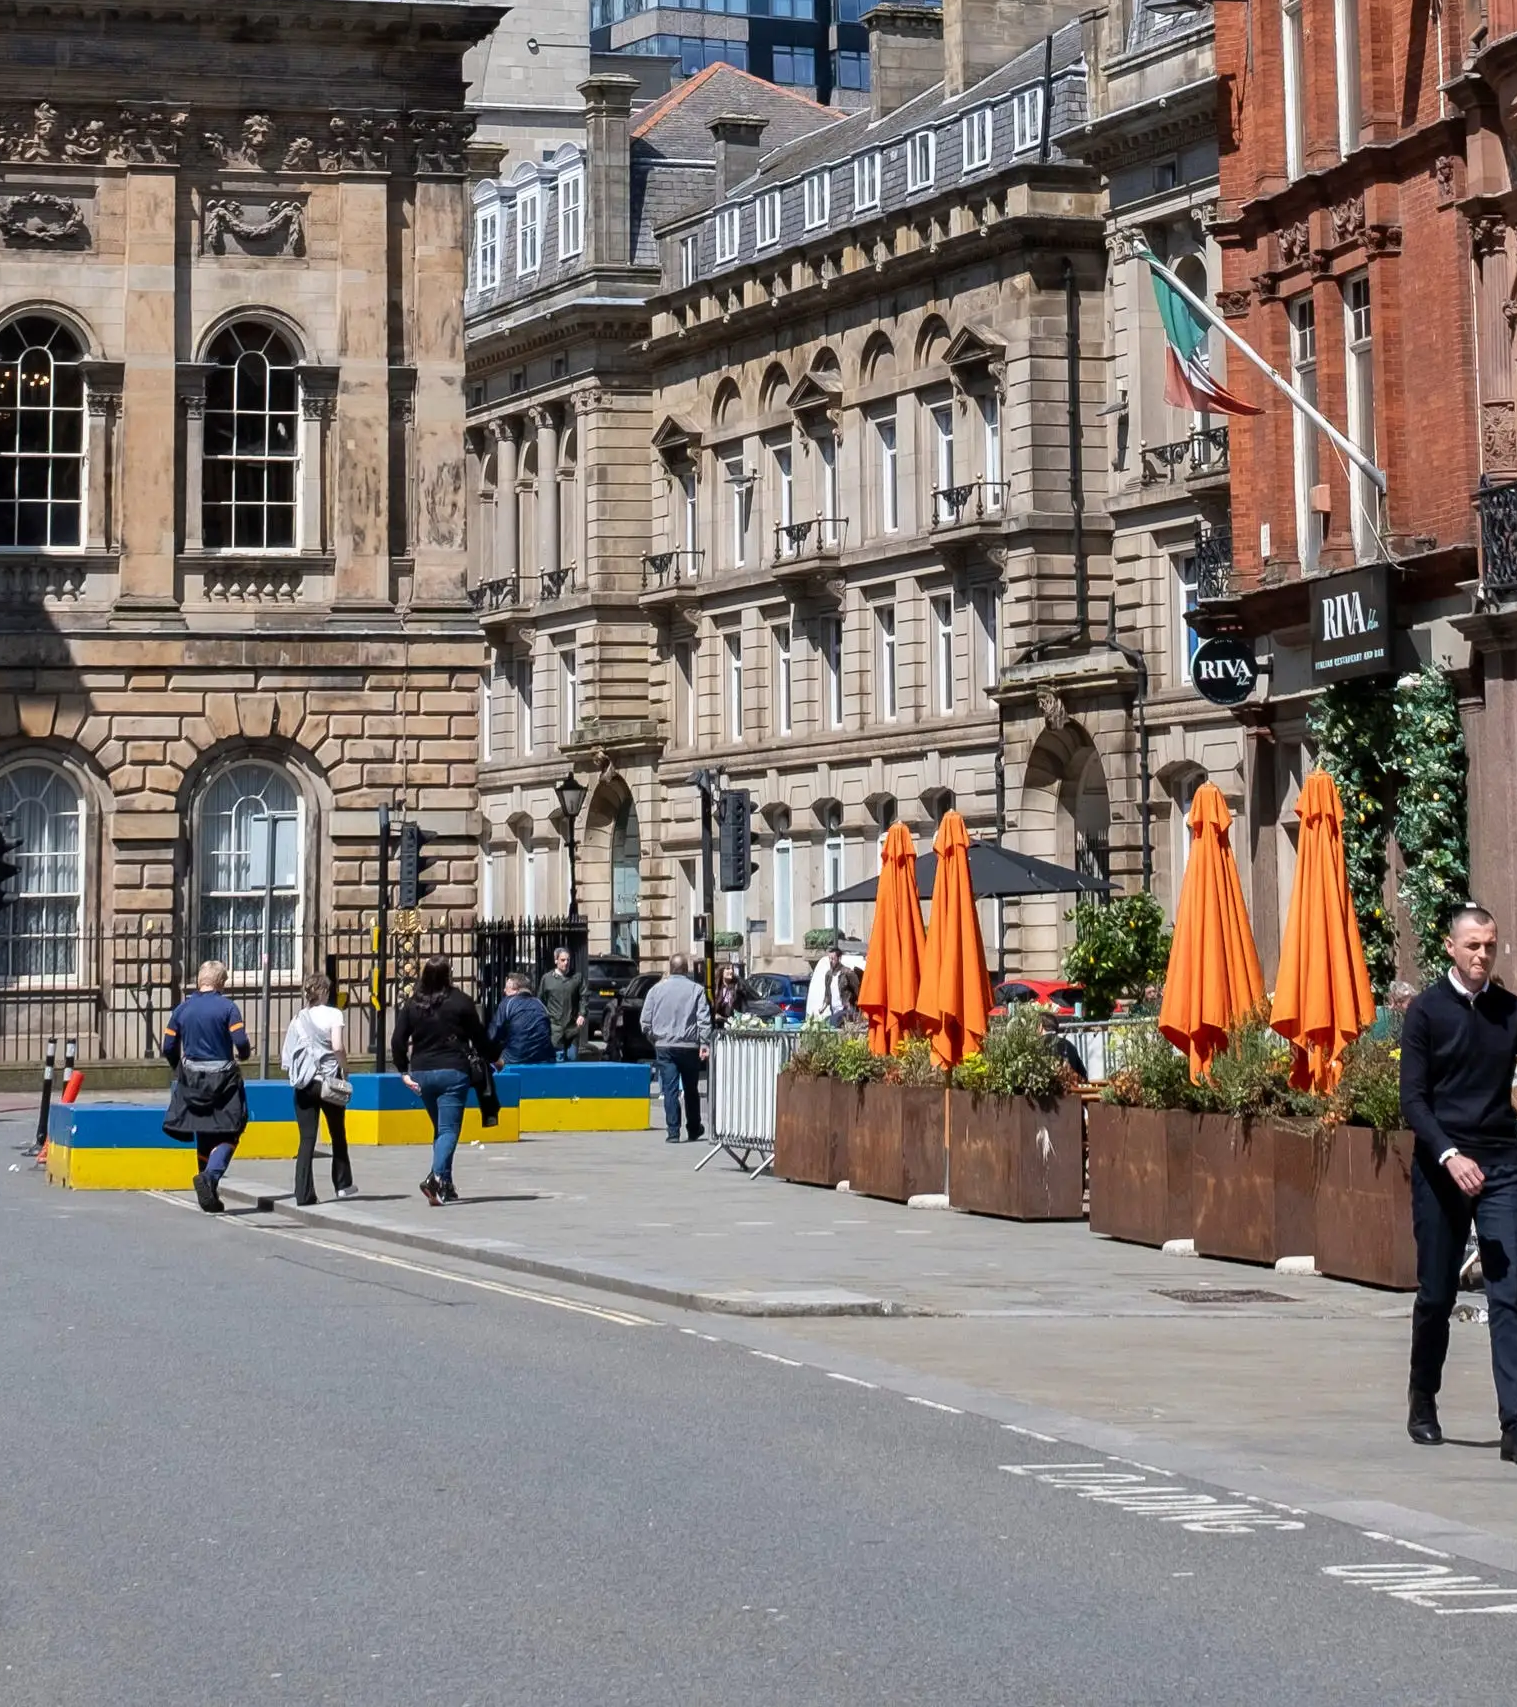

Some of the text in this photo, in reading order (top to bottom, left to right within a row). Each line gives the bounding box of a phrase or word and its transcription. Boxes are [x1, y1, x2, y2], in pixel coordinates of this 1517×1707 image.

[1322, 591, 1367, 641] RIVA
[1198, 658, 1254, 680] RIVA
[997, 1463, 1306, 1533] LOADING
